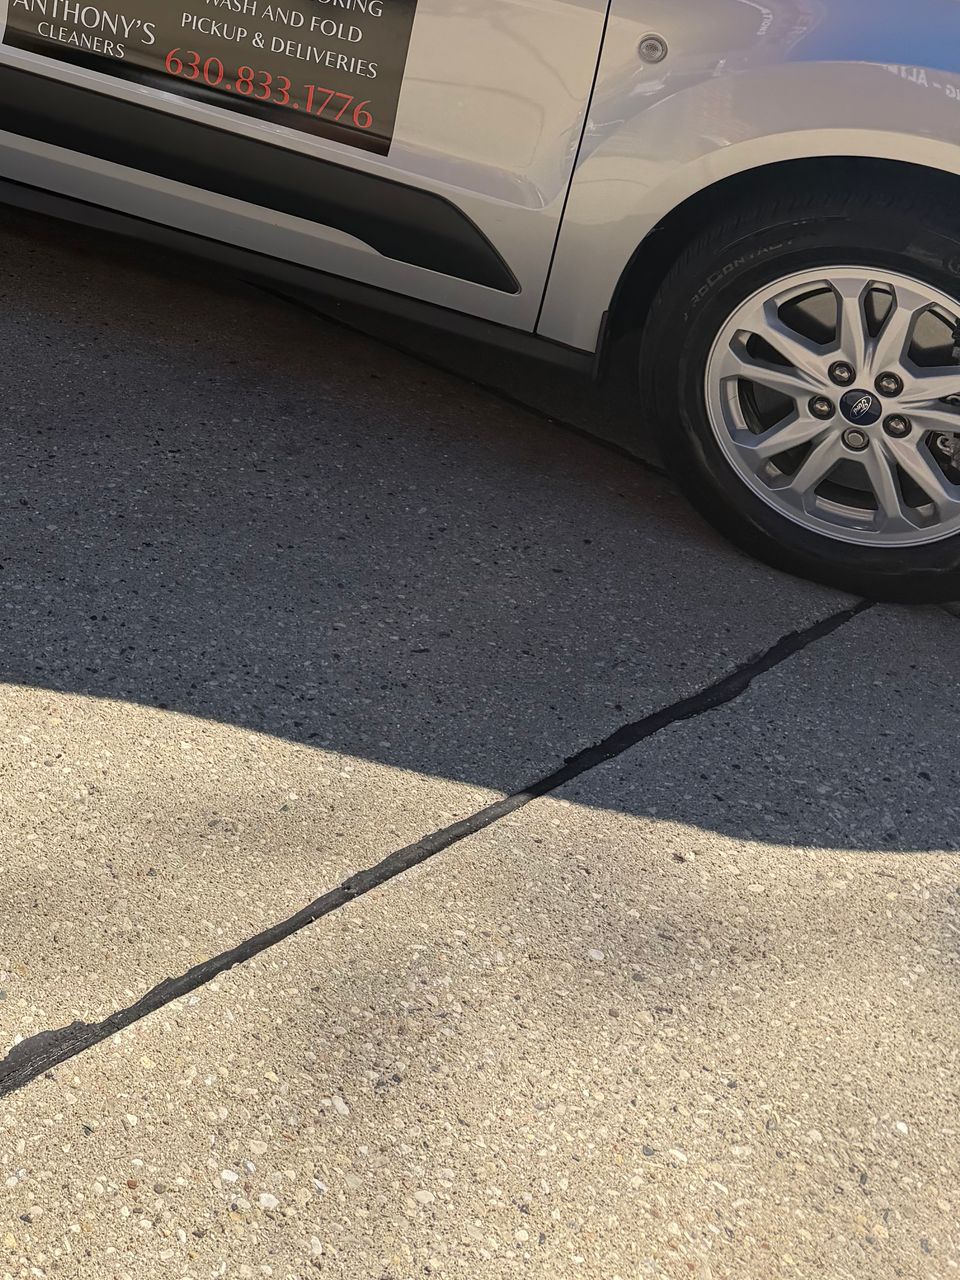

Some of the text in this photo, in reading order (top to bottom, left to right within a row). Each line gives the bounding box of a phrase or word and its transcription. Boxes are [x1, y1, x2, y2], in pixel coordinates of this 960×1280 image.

[37, 21, 126, 60] CLEANERS
[180, 12, 380, 80] PICKUP & DELIVERIES
[261, 4, 305, 29] AND
[309, 16, 364, 44] FOLD
[164, 47, 374, 129] 630.833.1776
